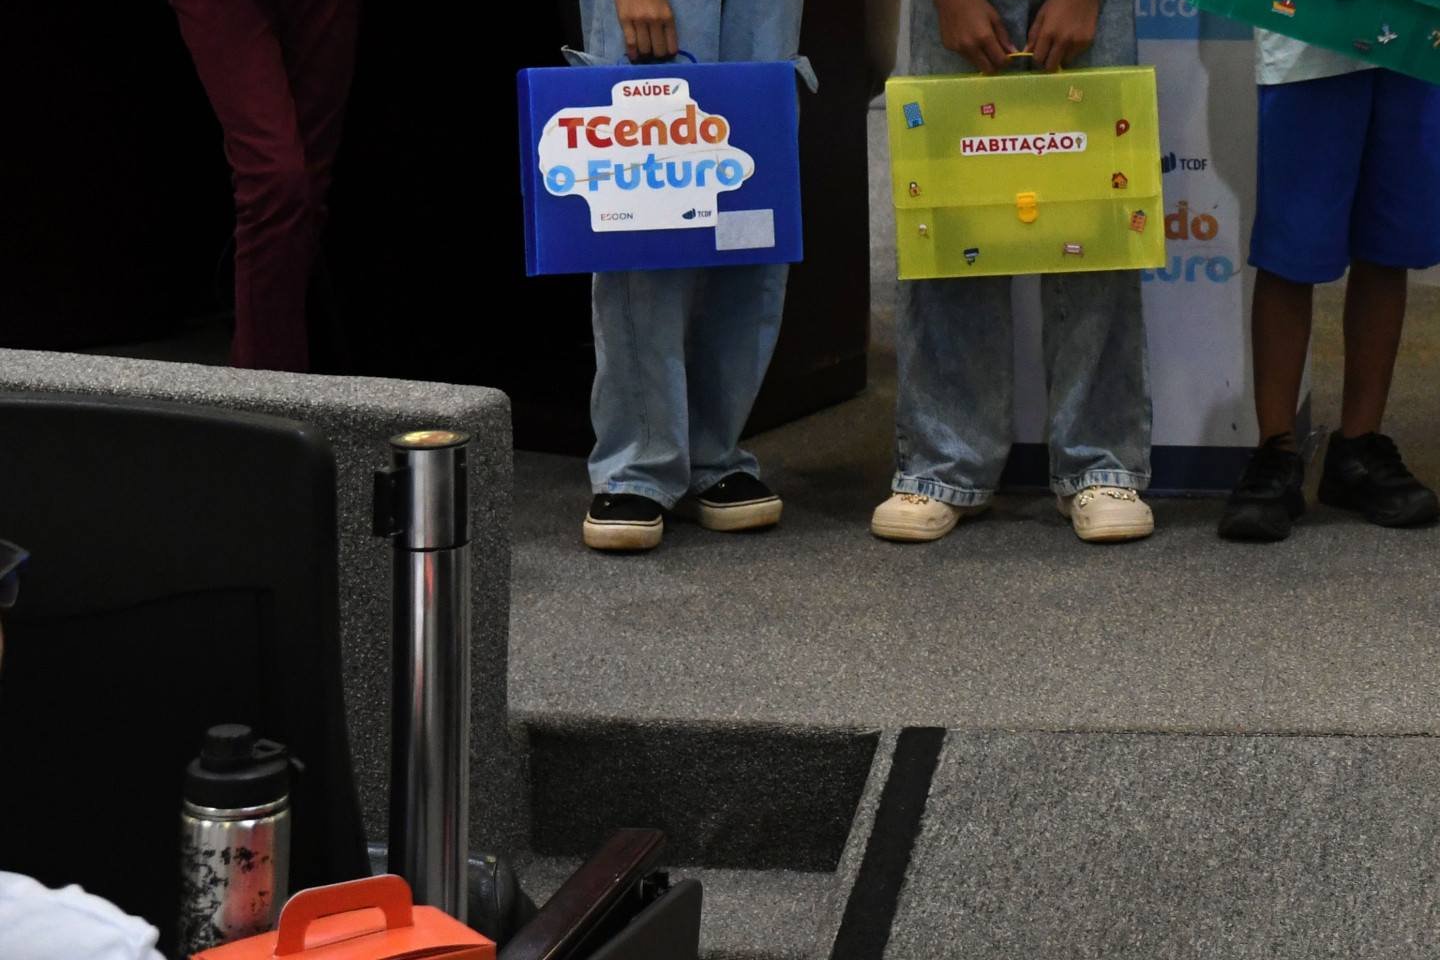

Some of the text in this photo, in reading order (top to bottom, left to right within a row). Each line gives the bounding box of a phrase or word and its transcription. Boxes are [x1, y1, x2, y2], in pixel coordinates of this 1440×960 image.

[622, 81, 671, 98] SAÚDE
[558, 104, 728, 149] TCendo
[961, 132, 1074, 155] HABITAÇÃO
[546, 152, 745, 193] o Futuro
[1179, 158, 1208, 171] TCDF
[600, 212, 634, 222] ESCON
